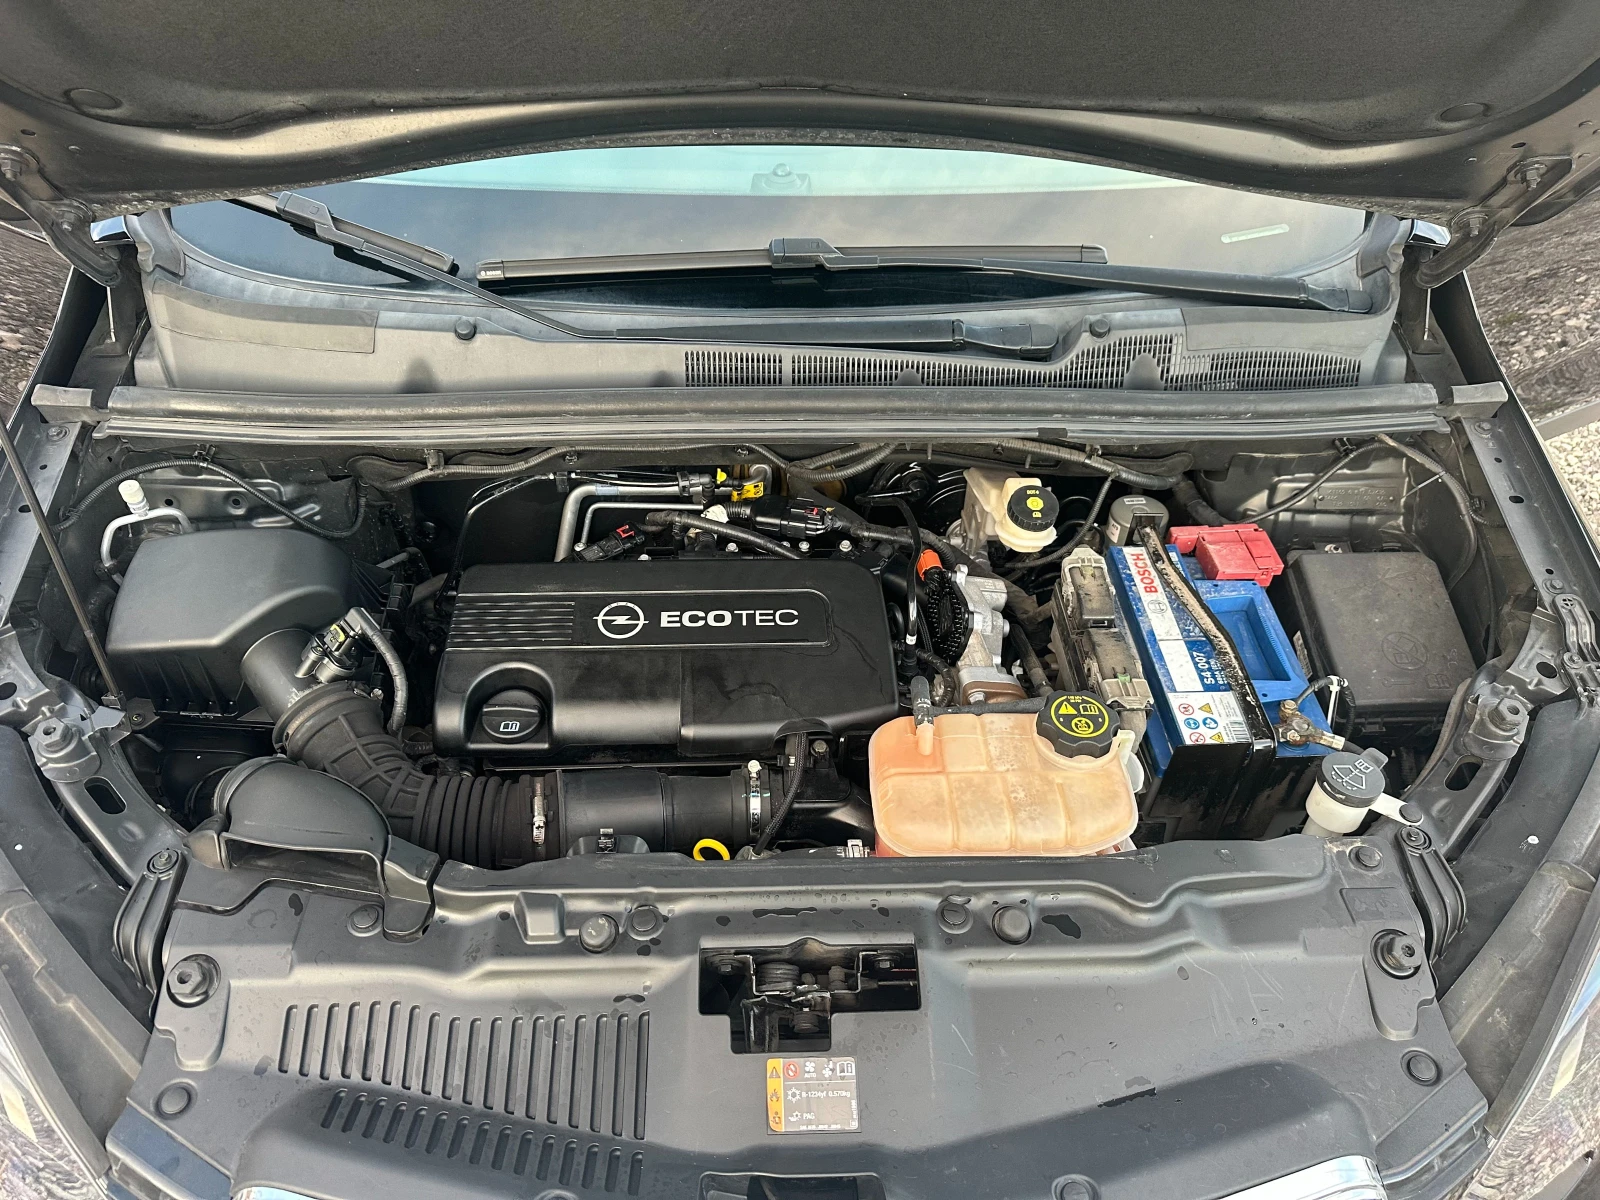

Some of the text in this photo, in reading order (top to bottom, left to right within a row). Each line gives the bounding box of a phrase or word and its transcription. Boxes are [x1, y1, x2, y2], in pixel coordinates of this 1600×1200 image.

[1130, 553, 1159, 593] BOSCH
[660, 609, 799, 628] ECOTEC
[1192, 651, 1215, 685] S4 007
[801, 1090, 851, 1098] R-1234yf 0.570kg
[803, 1112, 815, 1120] PAG
